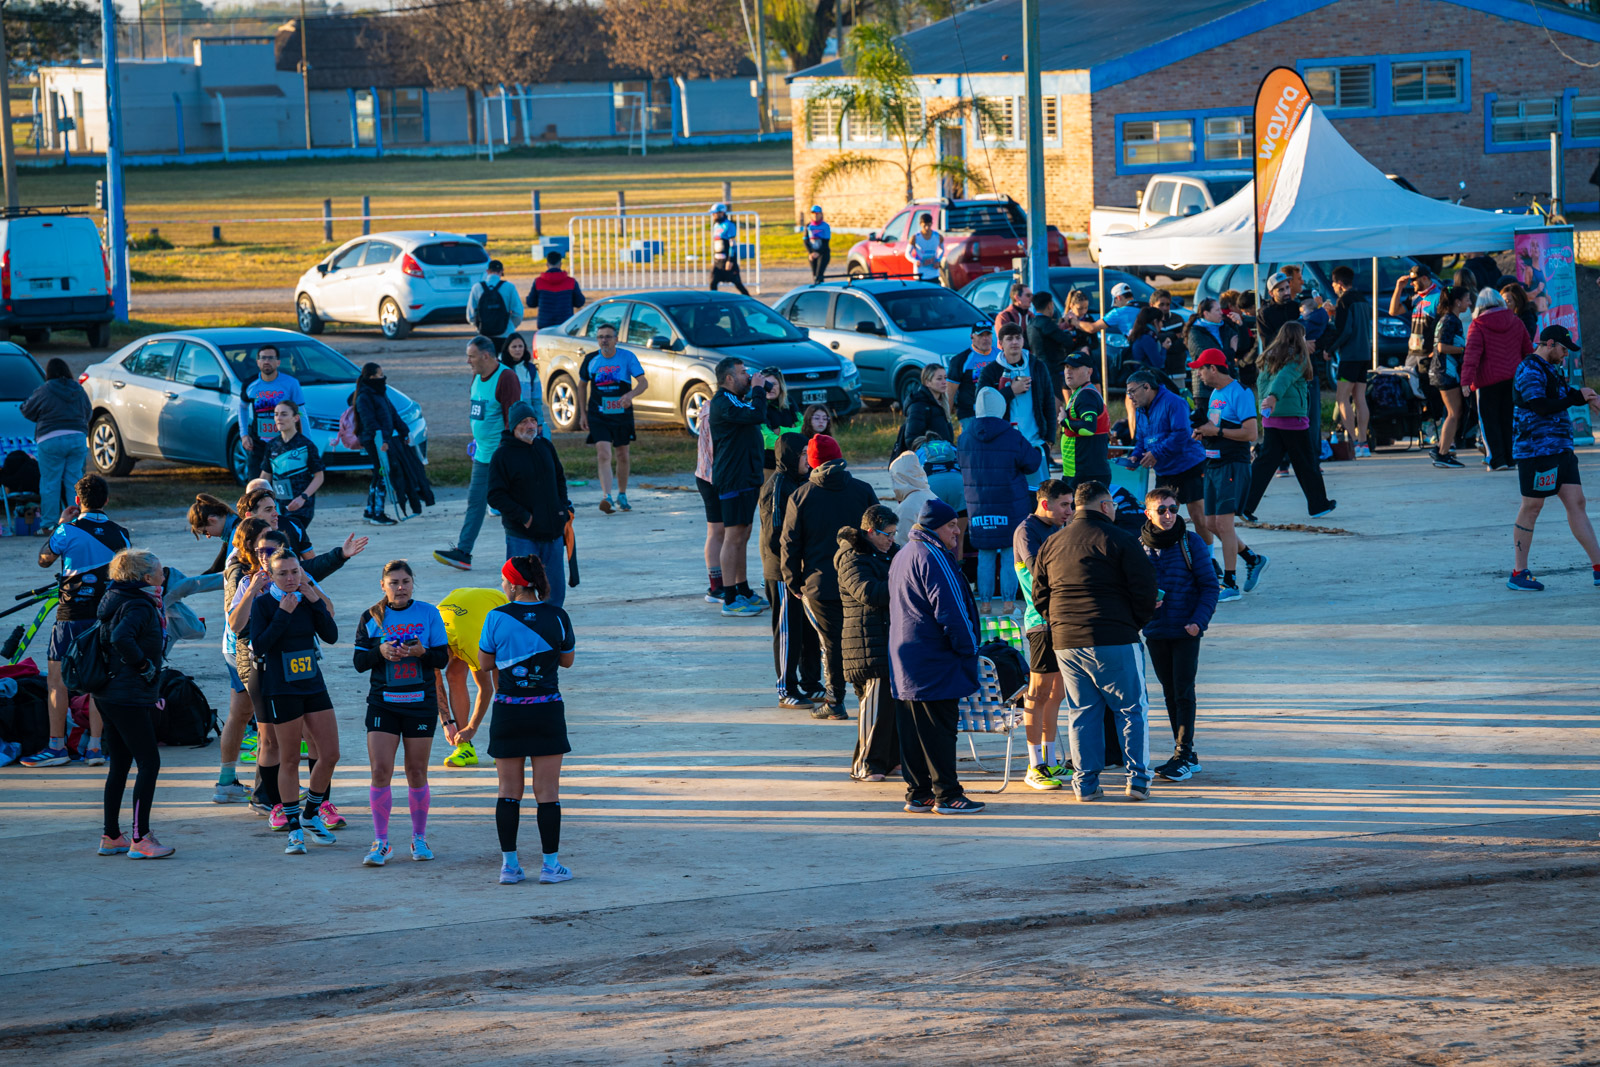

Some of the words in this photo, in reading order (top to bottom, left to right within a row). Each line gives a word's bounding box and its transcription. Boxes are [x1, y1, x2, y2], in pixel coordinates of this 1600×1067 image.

[1259, 86, 1299, 159] wayra
[1284, 110, 1299, 140] RUNNING
[1297, 95, 1310, 110] TEAM
[1549, 257, 1569, 268] ROSA
[1539, 473, 1555, 487] 322
[290, 656, 312, 674] 657
[394, 662, 417, 679] 225
